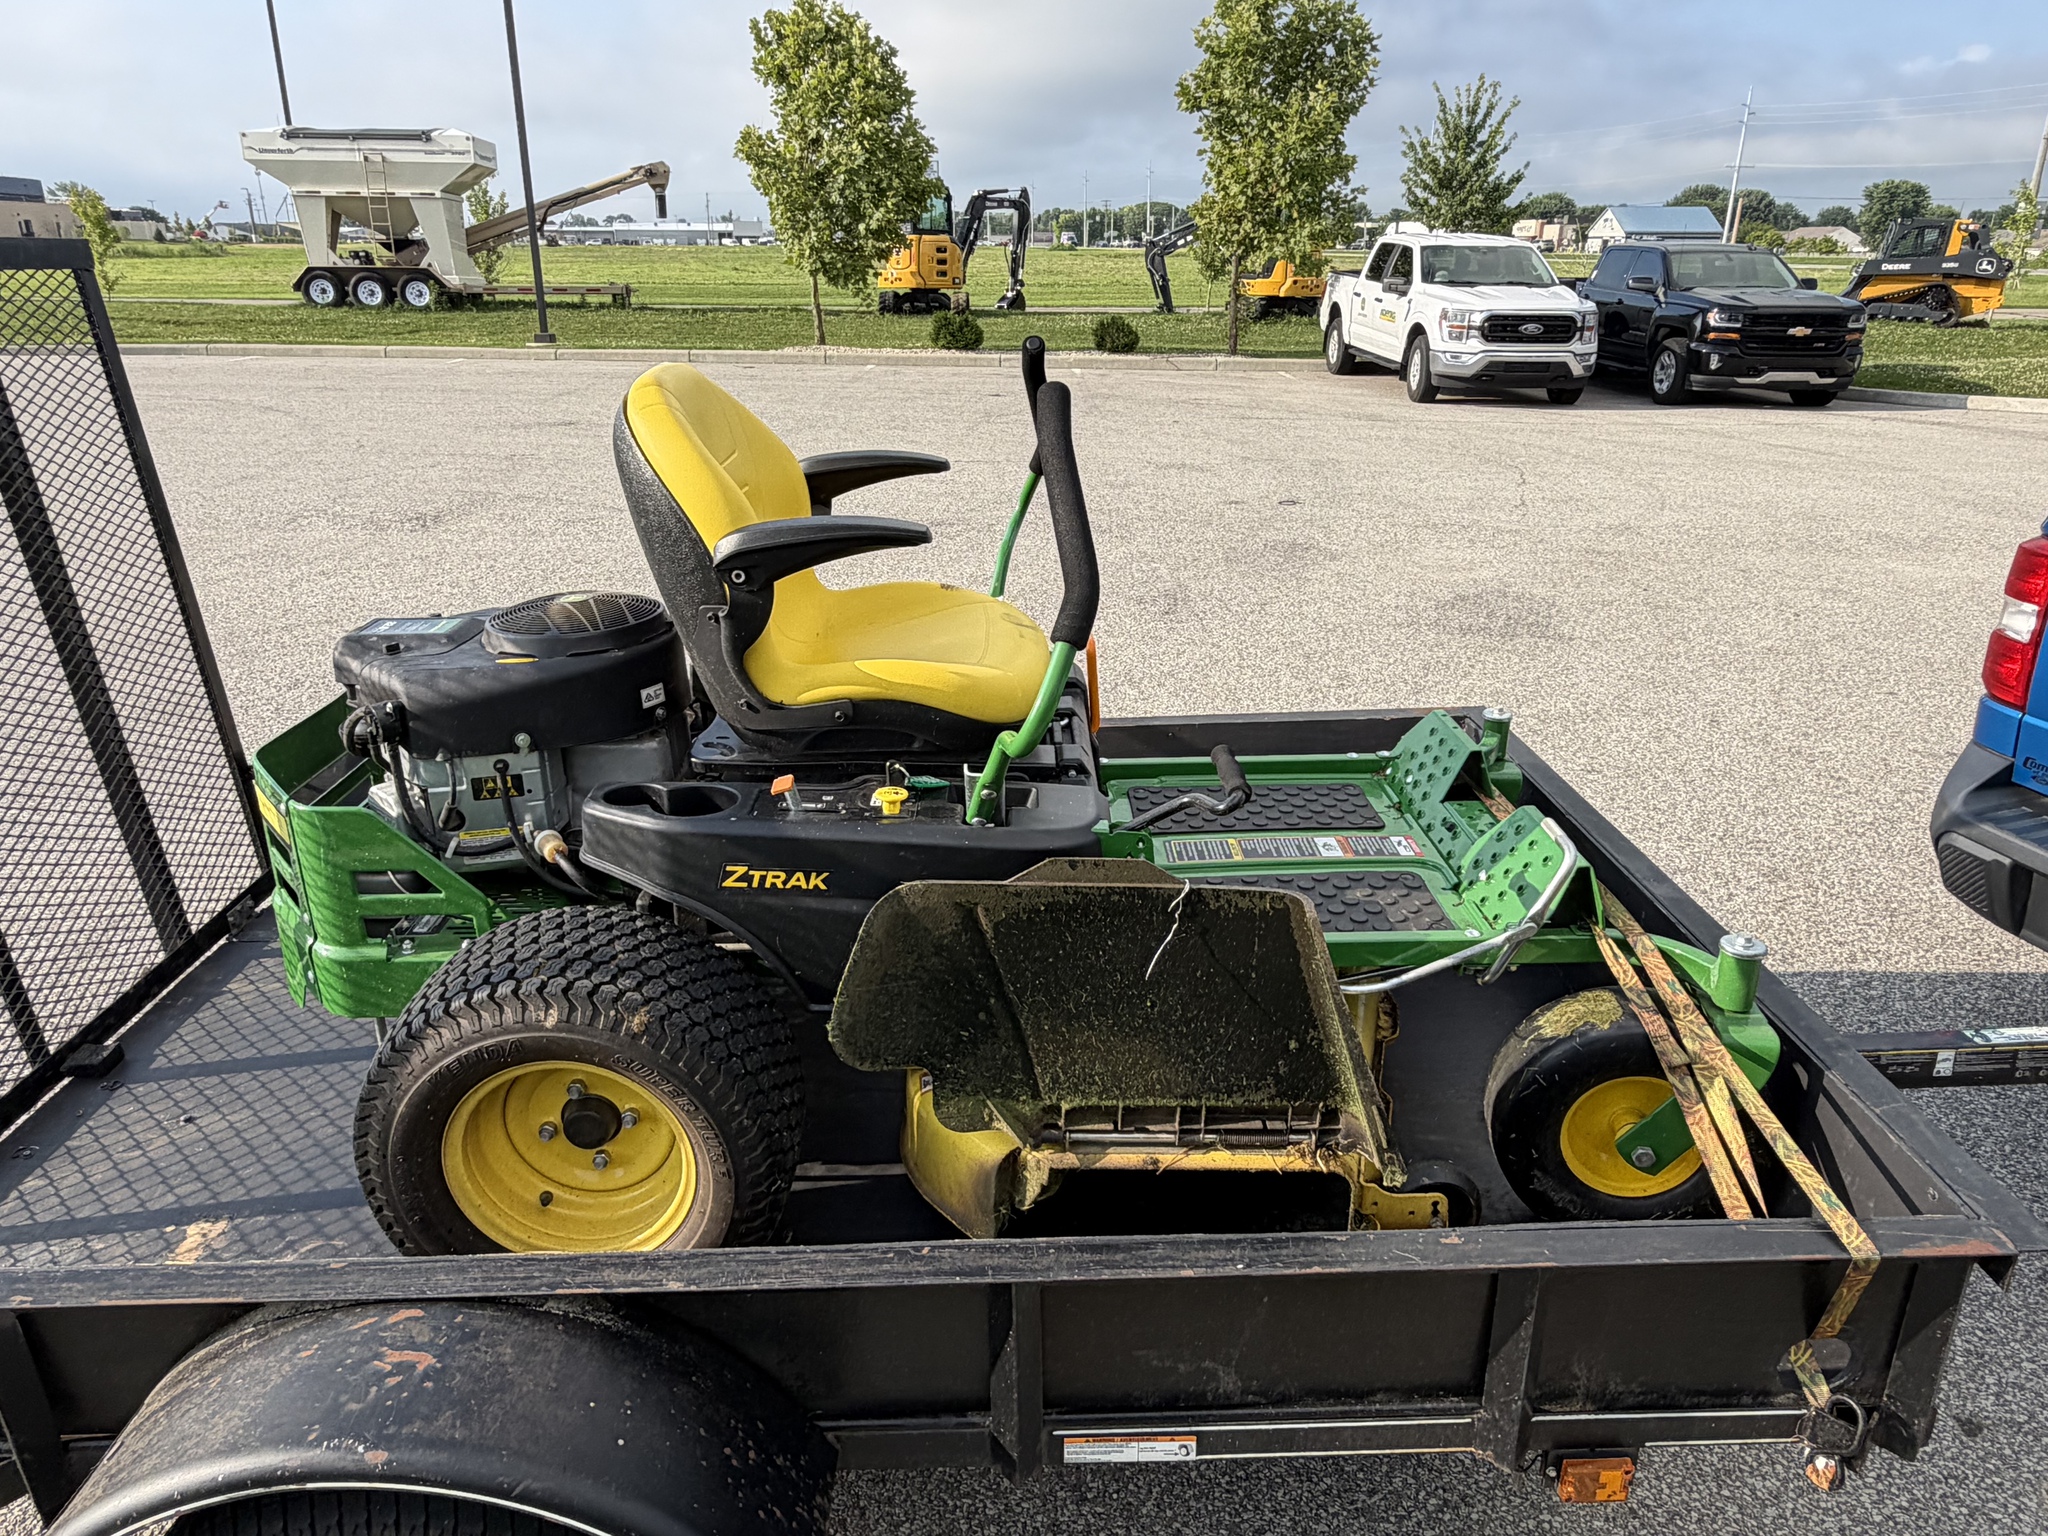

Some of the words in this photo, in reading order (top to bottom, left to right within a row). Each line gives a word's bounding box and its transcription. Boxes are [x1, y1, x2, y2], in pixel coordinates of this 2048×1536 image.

[1881, 263, 1911, 271] DEERE
[721, 865, 830, 890] ZTRAK
[610, 1053, 700, 1116] SUPER
